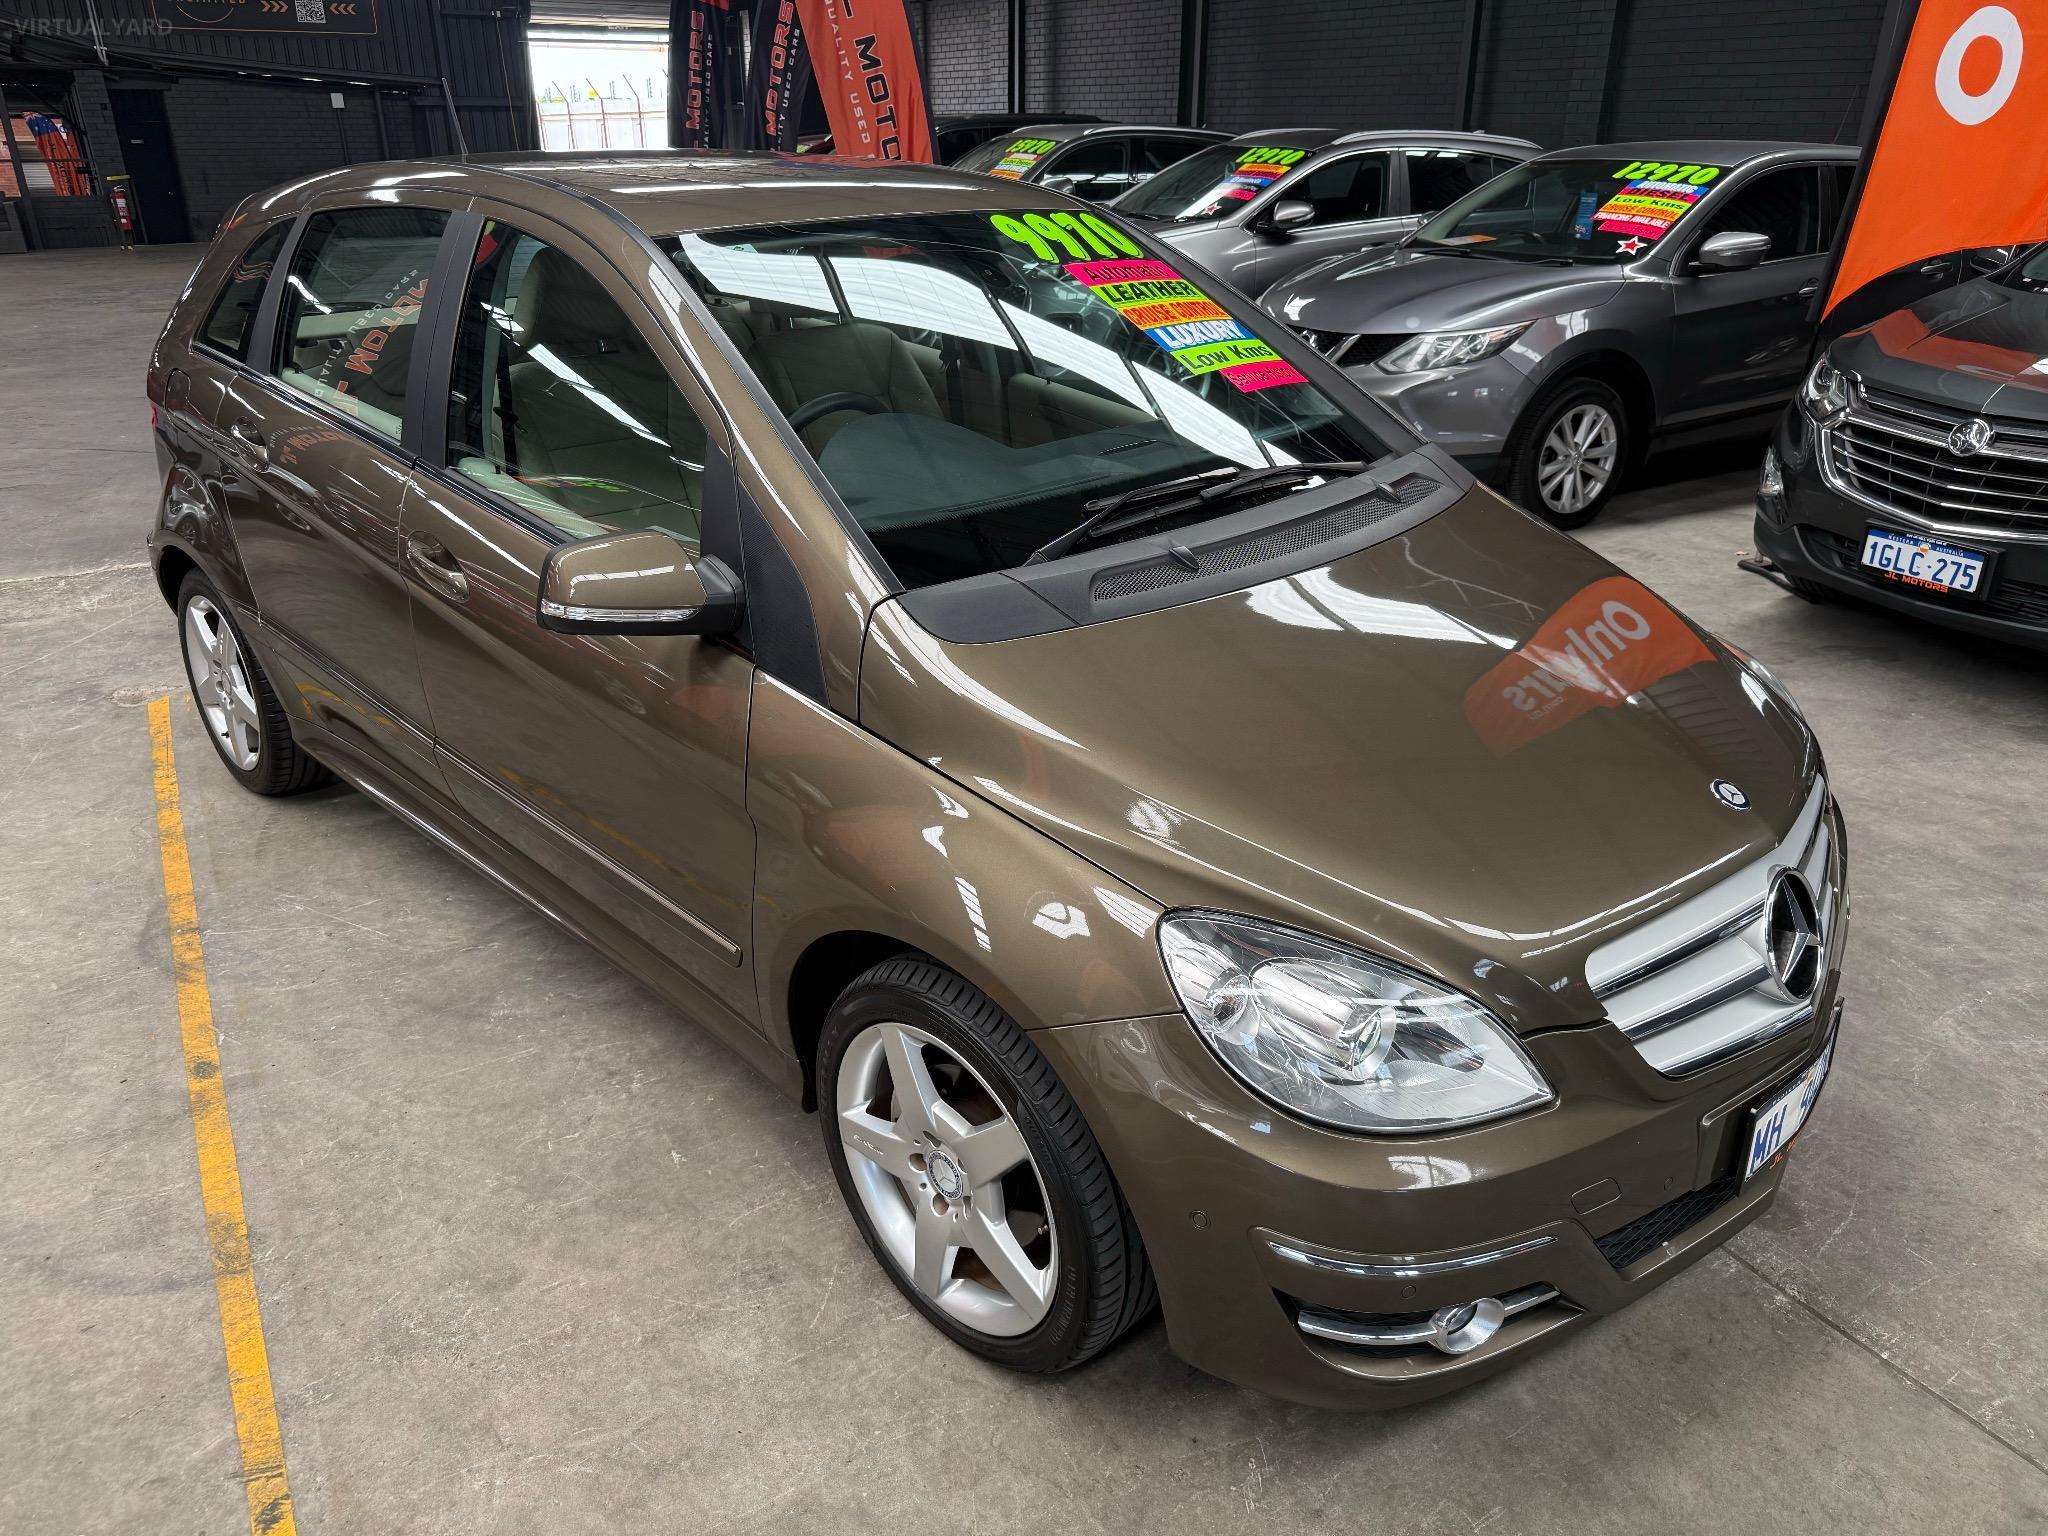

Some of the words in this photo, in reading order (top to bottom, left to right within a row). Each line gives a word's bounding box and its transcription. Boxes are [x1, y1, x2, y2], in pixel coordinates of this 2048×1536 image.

[765, 0, 794, 137] MOTORS
[782, 72, 792, 108] USED
[789, 28, 800, 66] CARS
[1935, 5, 2024, 126] O
[850, 92, 871, 144] USED
[1611, 161, 1720, 185] 12970
[1628, 188, 1689, 201] DIESEL
[1631, 215, 1671, 229] AVAILABLE
[989, 212, 1145, 264] 9970
[1083, 263, 1170, 282] Automatic
[1099, 279, 1199, 304] LEATHER
[1122, 304, 1176, 327] CRUISE
[1172, 299, 1231, 322] CONTROL
[1156, 318, 1249, 349] LUXURY
[1884, 571, 1900, 581] JL
[1901, 574, 1949, 593] MOTORS
